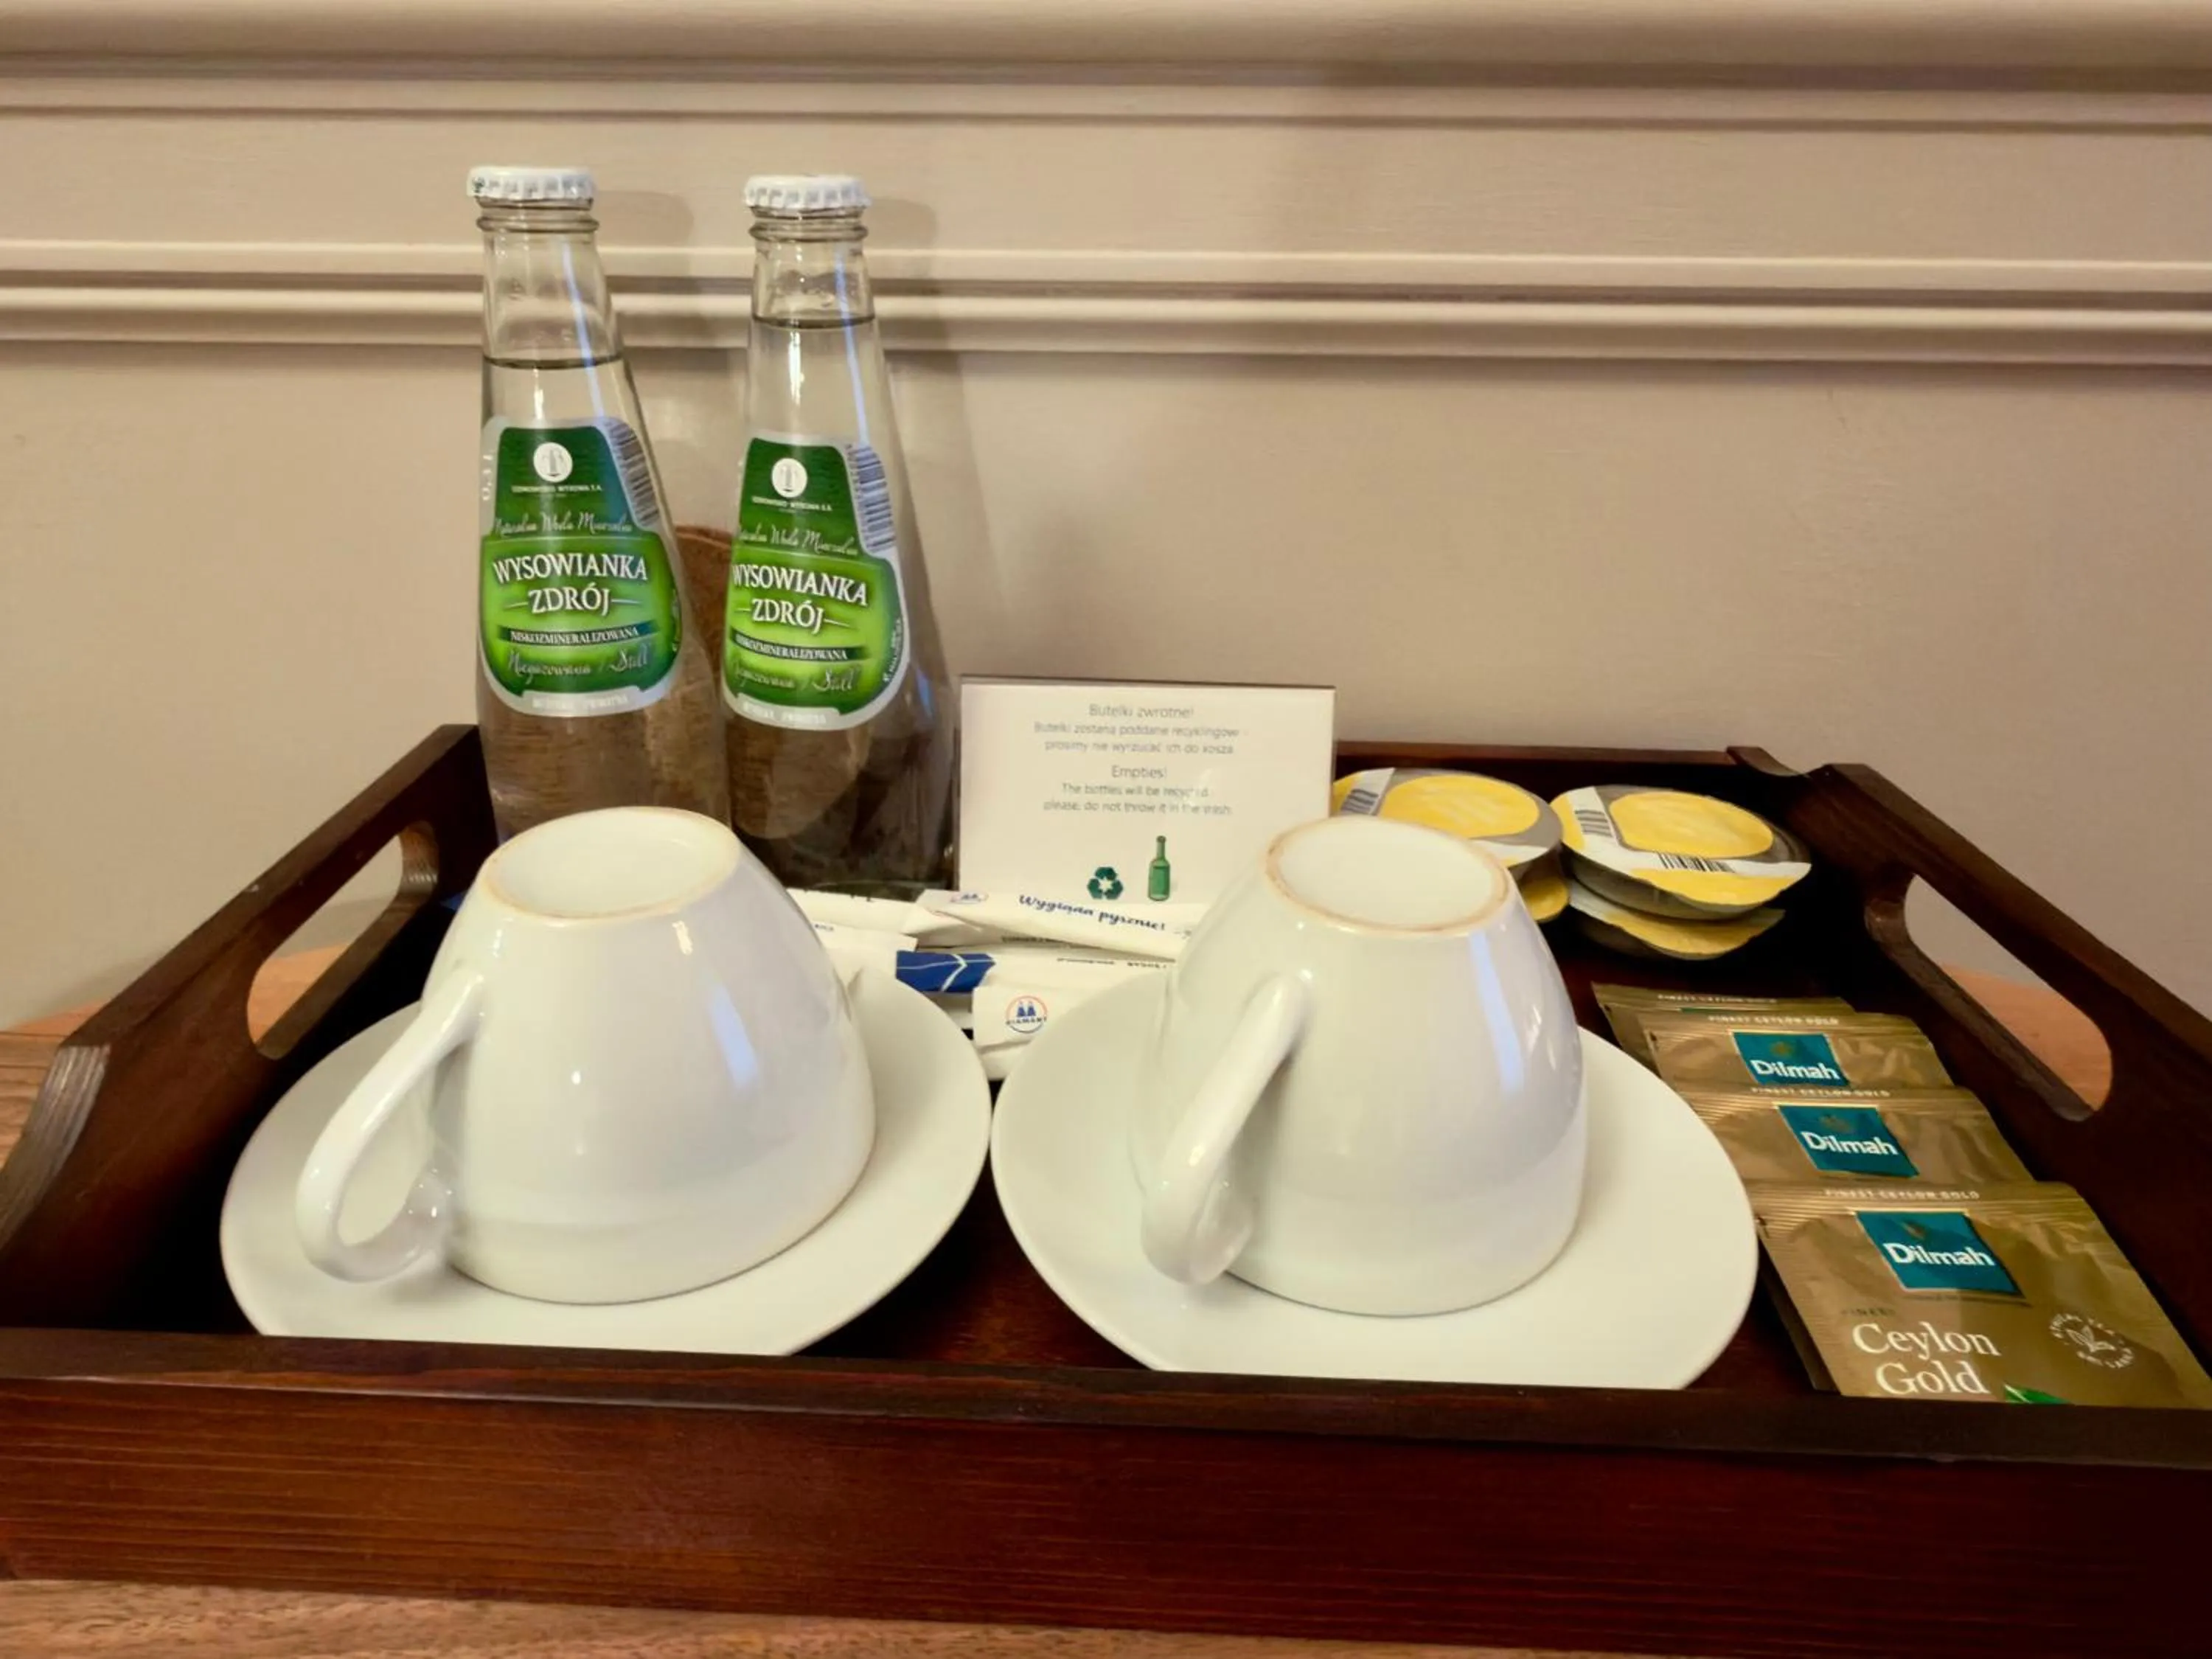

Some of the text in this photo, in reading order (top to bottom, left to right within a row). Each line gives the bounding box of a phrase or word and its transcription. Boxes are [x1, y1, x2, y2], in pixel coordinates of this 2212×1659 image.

[493, 552, 648, 584] WYSOWIANKA
[731, 563, 869, 606] WYSOWIANKA
[527, 582, 611, 617] ZDRÓJ
[751, 598, 824, 634] ZDRÓJ
[1088, 702, 1194, 719] Butelki zwrotne!
[1110, 764, 1168, 779] Empties!
[1062, 782, 1082, 795] The
[1145, 785, 1161, 797] be
[1082, 800, 1100, 811] do
[1102, 801, 1121, 812] not
[1750, 1059, 1841, 1080] Dilmah
[1800, 1130, 1899, 1155] Dilmah
[1882, 1242, 1997, 1267] Dilmah
[1851, 1321, 2002, 1361] Ceylon
[1875, 1360, 1991, 1396] Gold
